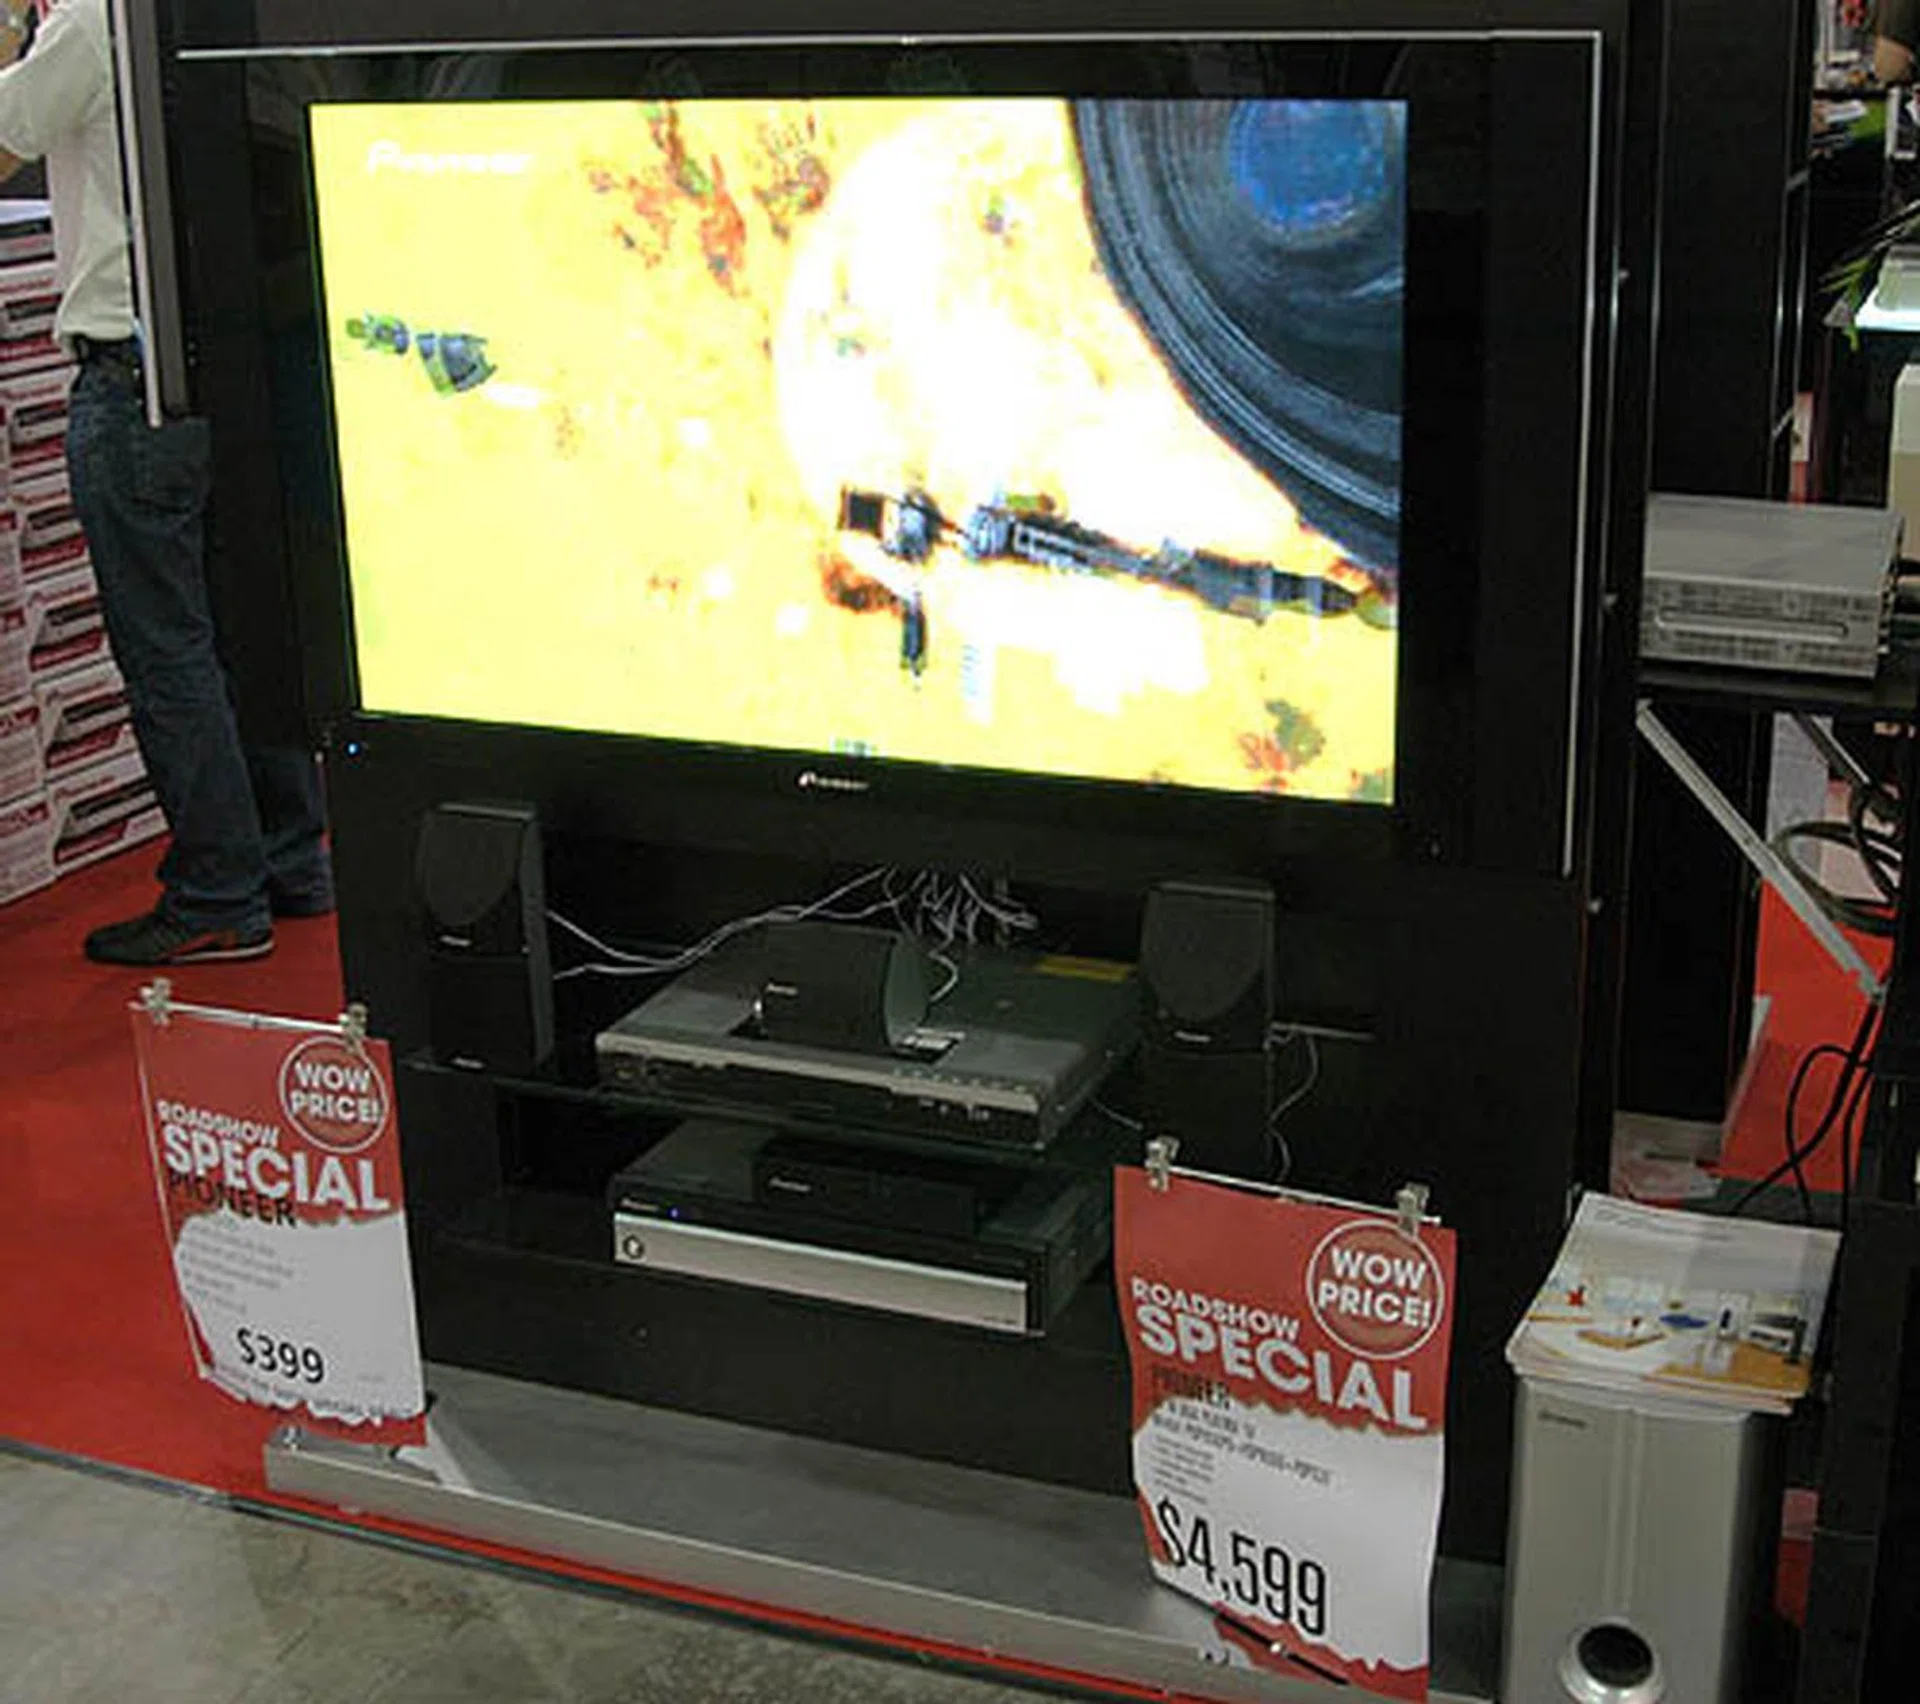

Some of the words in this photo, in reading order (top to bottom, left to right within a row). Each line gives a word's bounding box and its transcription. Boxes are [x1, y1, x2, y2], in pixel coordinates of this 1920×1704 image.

[293, 1060, 371, 1093] WOW
[156, 1100, 280, 1149] ROADSHOW
[289, 1088, 382, 1124] PRICE!
[161, 1124, 391, 1211] SPECIAL
[169, 1173, 298, 1229] PIONEER
[1331, 1247, 1427, 1290] WOW
[1130, 1275, 1299, 1341] ROADSHOW
[1317, 1279, 1432, 1329] PRICE!
[236, 1327, 325, 1385] $399
[1136, 1304, 1429, 1430] SPECIAL
